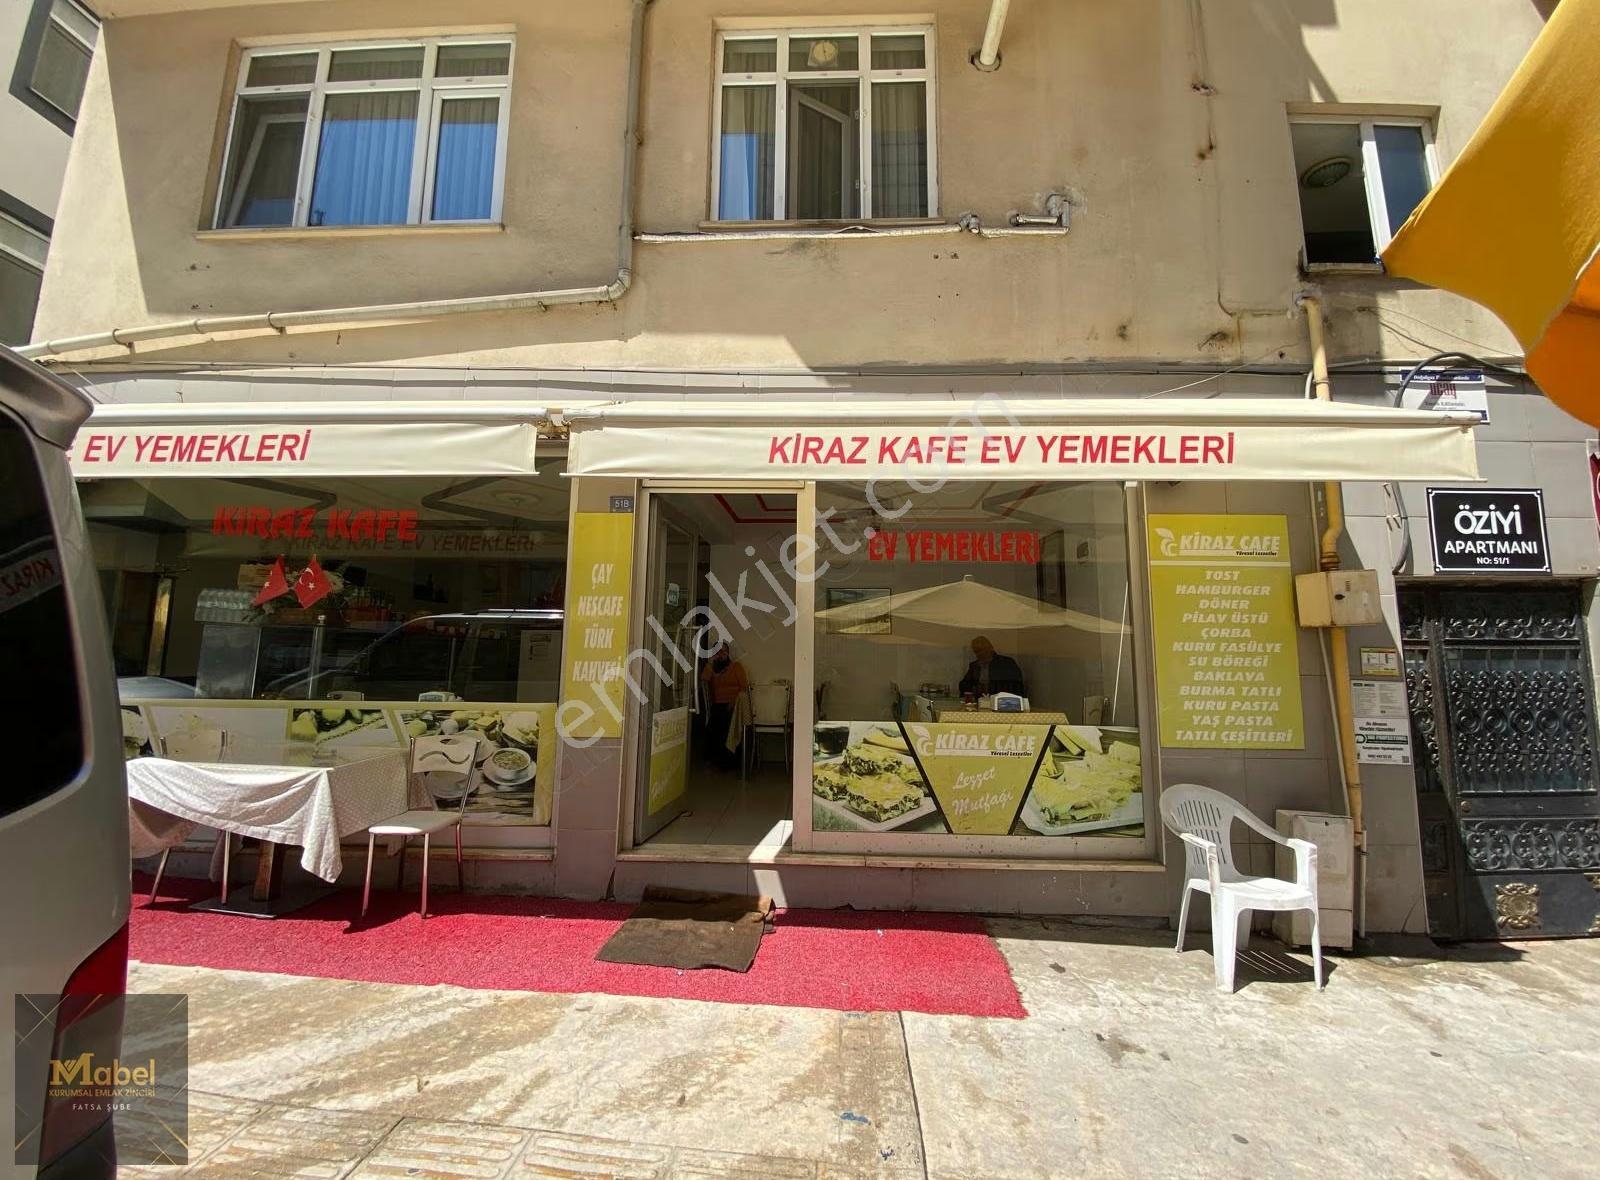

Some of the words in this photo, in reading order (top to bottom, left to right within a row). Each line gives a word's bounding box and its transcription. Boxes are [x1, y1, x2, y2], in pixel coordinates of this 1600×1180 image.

[84, 435, 128, 463] EV
[135, 429, 312, 463] YEMEKLERİ
[768, 432, 867, 465] KİRAZ
[878, 435, 967, 465] KAFE
[981, 435, 1026, 464] EV
[1036, 431, 1235, 465] YEMEKLERİ
[615, 499, 630, 508] 51B
[327, 505, 419, 542] KAFE
[1454, 504, 1522, 535] ÖZİYİ
[868, 530, 898, 561] EV
[905, 528, 1040, 565] YEMEKLERİ
[1179, 532, 1235, 550] KİRAZ
[1239, 536, 1281, 551] CAFE
[1444, 540, 1538, 554] APARTMANI
[1476, 557, 1492, 565] NO:
[1493, 557, 1510, 565] 51/1
[591, 563, 614, 589] ÇAY
[1205, 571, 1240, 581] TOST
[1176, 585, 1271, 596] HAMBURGER
[577, 596, 624, 617] NESCAFE
[1199, 599, 1250, 610] DÖNER
[1182, 612, 1228, 623] PİLAV
[1231, 612, 1269, 624] ÜSTÜ
[584, 624, 615, 649] TÜRK
[1201, 628, 1251, 640] ÇORBA
[1172, 642, 1216, 652] KURU
[1219, 640, 1283, 653] FASÜLYE
[1188, 656, 1208, 667] SU
[1193, 671, 1265, 681] BAKLAVA
[1180, 686, 1236, 696] BURMA
[1241, 686, 1282, 697] TATLI
[1183, 700, 1227, 711] KURU
[1231, 701, 1280, 712] PASTA
[1192, 715, 1221, 728] YAŞ
[1224, 716, 1273, 726] PASTA
[935, 730, 990, 749] KİRAZ
[994, 735, 1036, 751] CAFE
[1176, 730, 1217, 741] TATLI
[1221, 729, 1293, 744] ÇEŞİTLERİ
[952, 766, 996, 790] Lezzet
